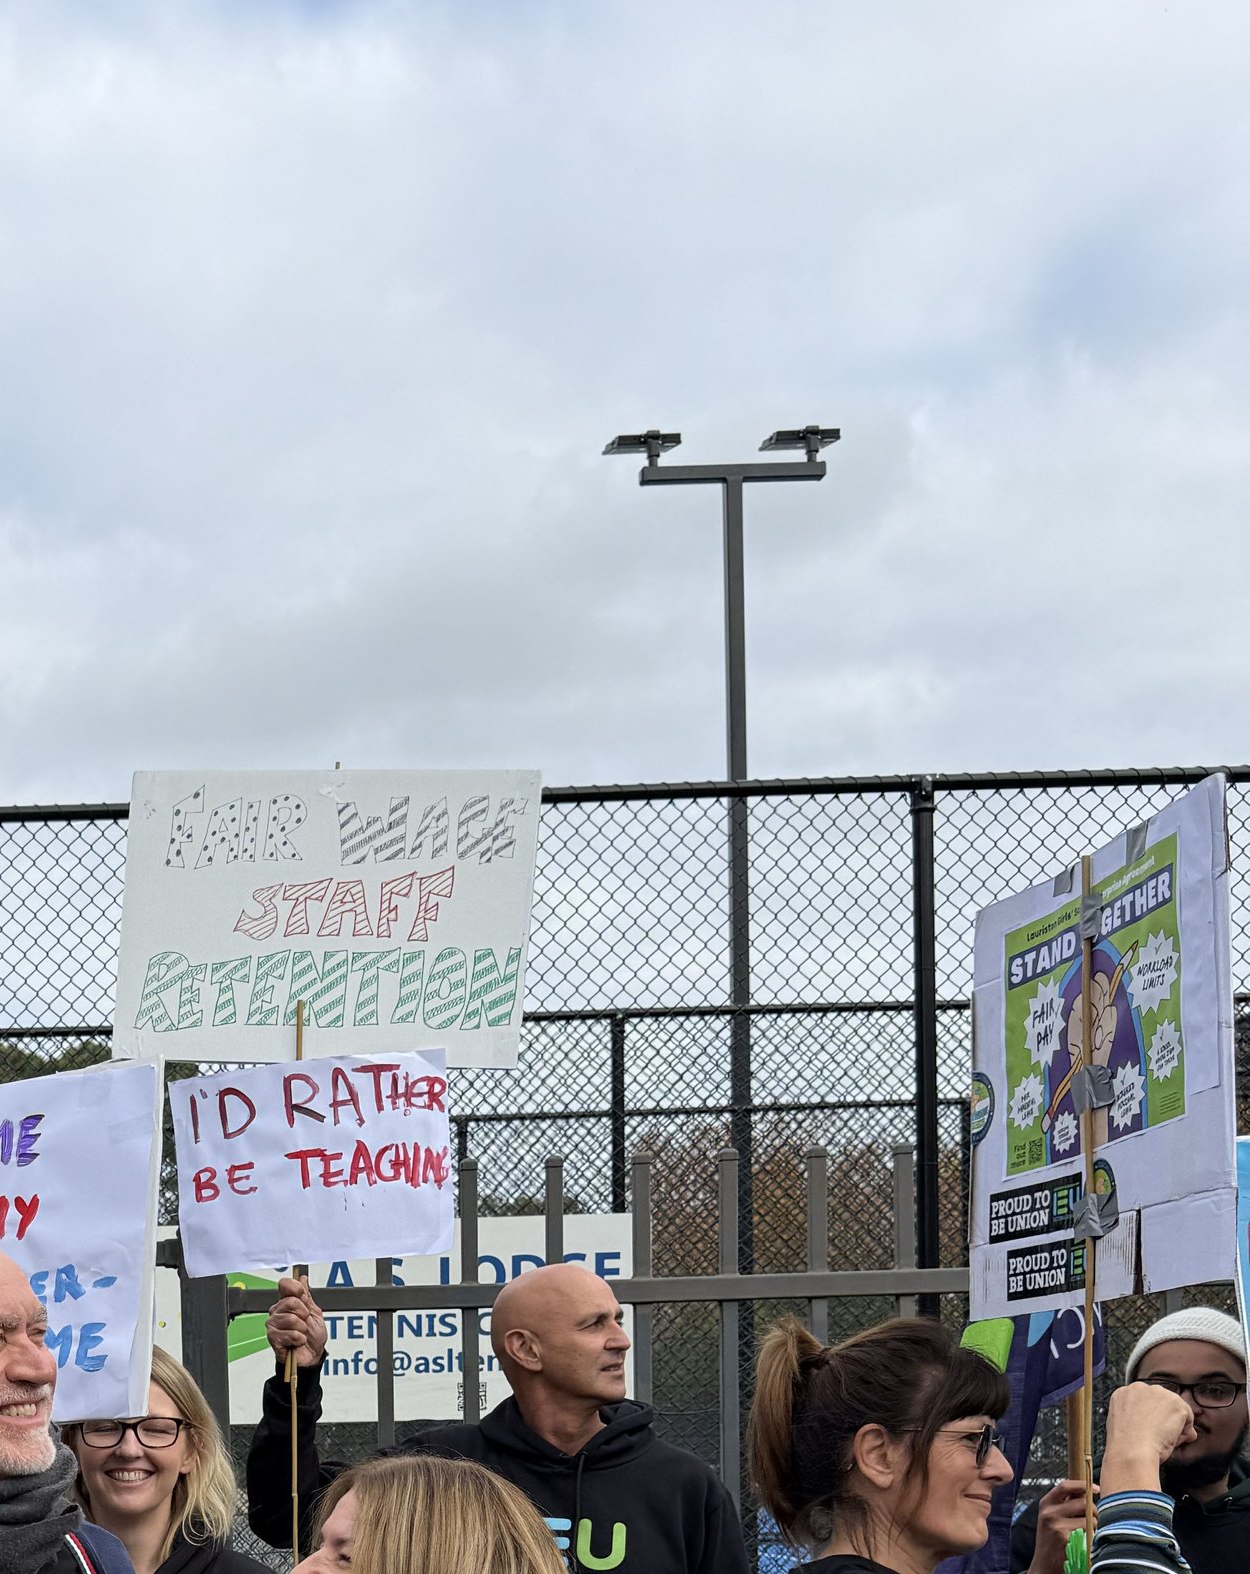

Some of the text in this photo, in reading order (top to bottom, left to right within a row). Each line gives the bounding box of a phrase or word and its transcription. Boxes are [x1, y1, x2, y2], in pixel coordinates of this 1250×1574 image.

[165, 784, 529, 869] FAIR WAGE
[233, 865, 455, 941] STAFF
[1010, 871, 1171, 985] STAND GETHER
[134, 946, 523, 1033] RETENTION
[1142, 974, 1166, 992] LIMITS
[1032, 997, 1055, 1026] FAIR
[1036, 1025, 1054, 1052] PAY
[190, 1063, 448, 1144] I'D RATHER
[192, 1139, 450, 1203] BE TEACHING
[991, 1195, 1032, 1218] PROUD
[1034, 1190, 1050, 1207] TO
[990, 1209, 1050, 1236] BE UNION
[1008, 1253, 1050, 1275] PROUD
[1051, 1248, 1067, 1266] TO
[1009, 1268, 1066, 1293] BE UNION
